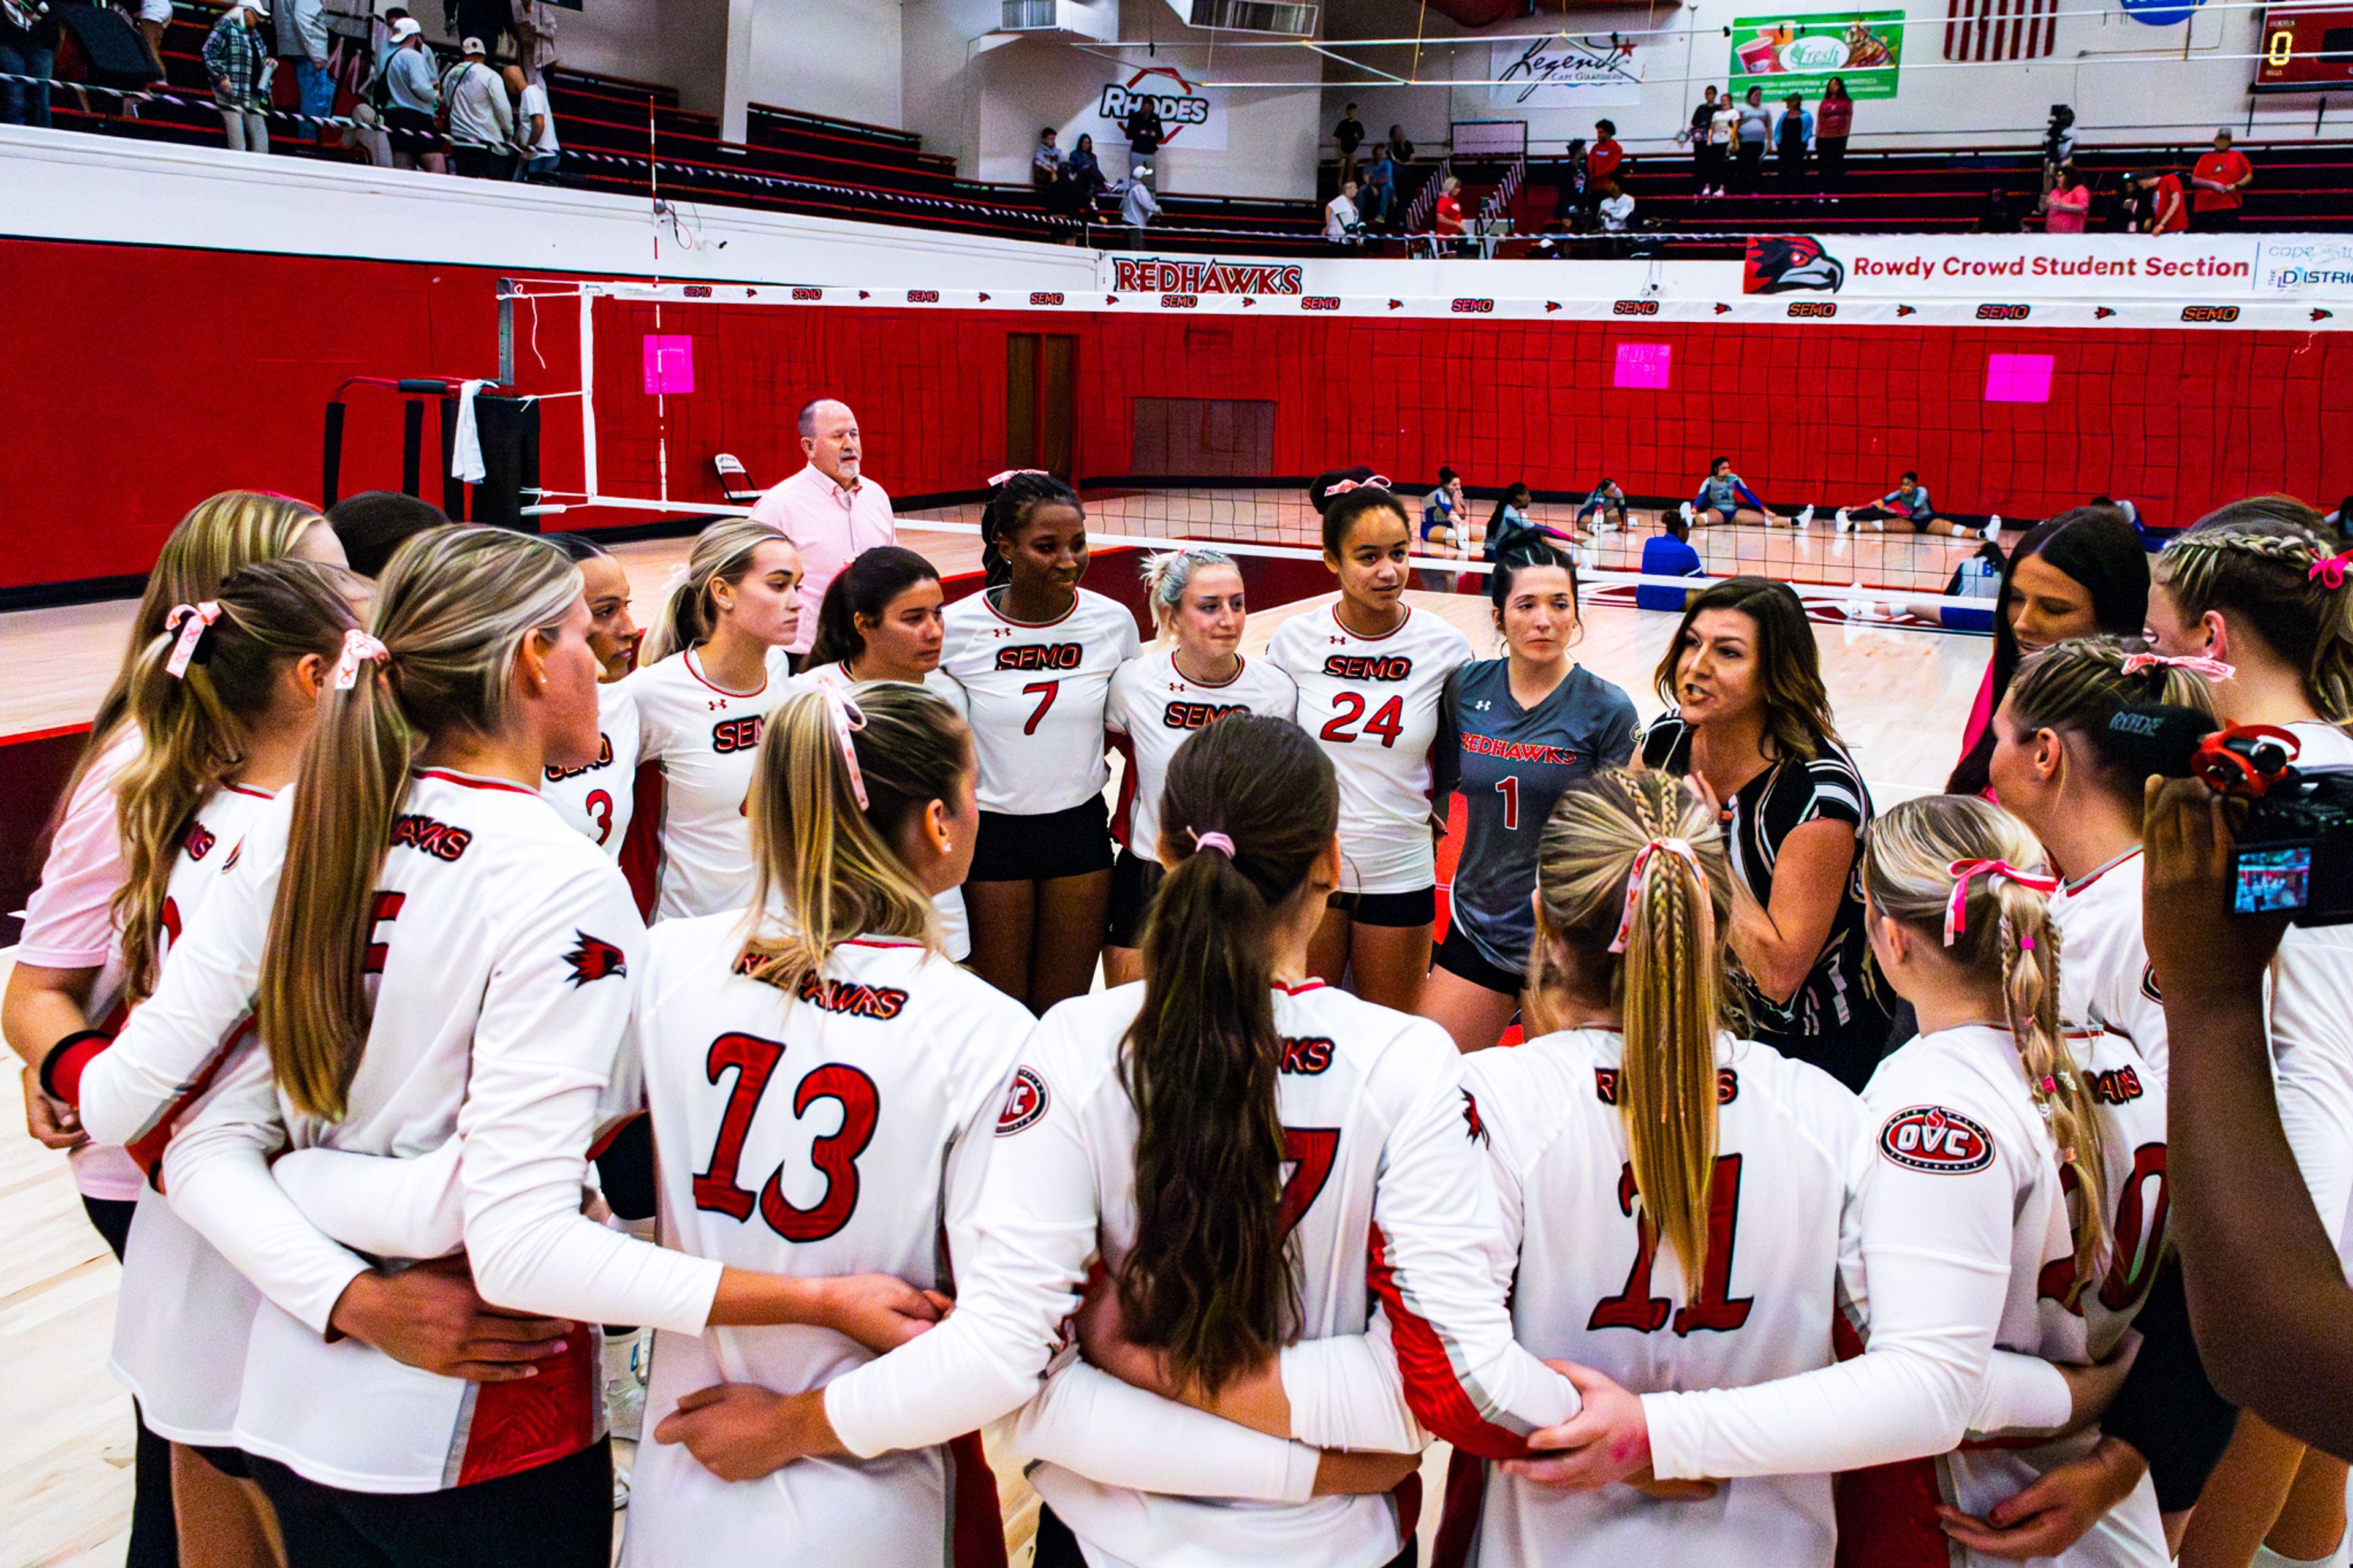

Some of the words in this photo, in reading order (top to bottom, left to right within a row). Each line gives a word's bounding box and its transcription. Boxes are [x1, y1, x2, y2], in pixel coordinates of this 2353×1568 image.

[2269, 32, 2292, 66] 0
[1100, 85, 1208, 125] RHDES
[1113, 257, 1302, 295] REDHAWKS
[1854, 256, 1936, 280] Rowdy
[1943, 256, 2025, 275] Crowd
[2032, 256, 2137, 275] Student
[2145, 256, 2249, 276] Section
[2283, 270, 2353, 284] DISTRI
[684, 286, 711, 297] SEMO
[792, 288, 822, 300] SEMO
[907, 290, 939, 302] SEMO
[1030, 292, 1064, 305] SEMO
[1161, 295, 1197, 308] SEMO
[1302, 297, 1340, 310] SEMO
[1452, 298, 1494, 312] SEMO
[1613, 301, 1659, 315] SEMO
[1787, 303, 1837, 317] SEMO
[1976, 304, 2031, 320] SEMO
[2181, 306, 2240, 322] SEMO
[995, 643, 1083, 671] SEMO
[1323, 656, 1412, 681] SEMO
[1022, 680, 1059, 735] 7
[1319, 691, 1404, 749] 24
[1461, 732, 1577, 765] REDHAWKS
[1495, 776, 1518, 830] 1
[586, 789, 613, 846] 3
[693, 1032, 881, 1243] 13
[1896, 1123, 1969, 1157] OVC
